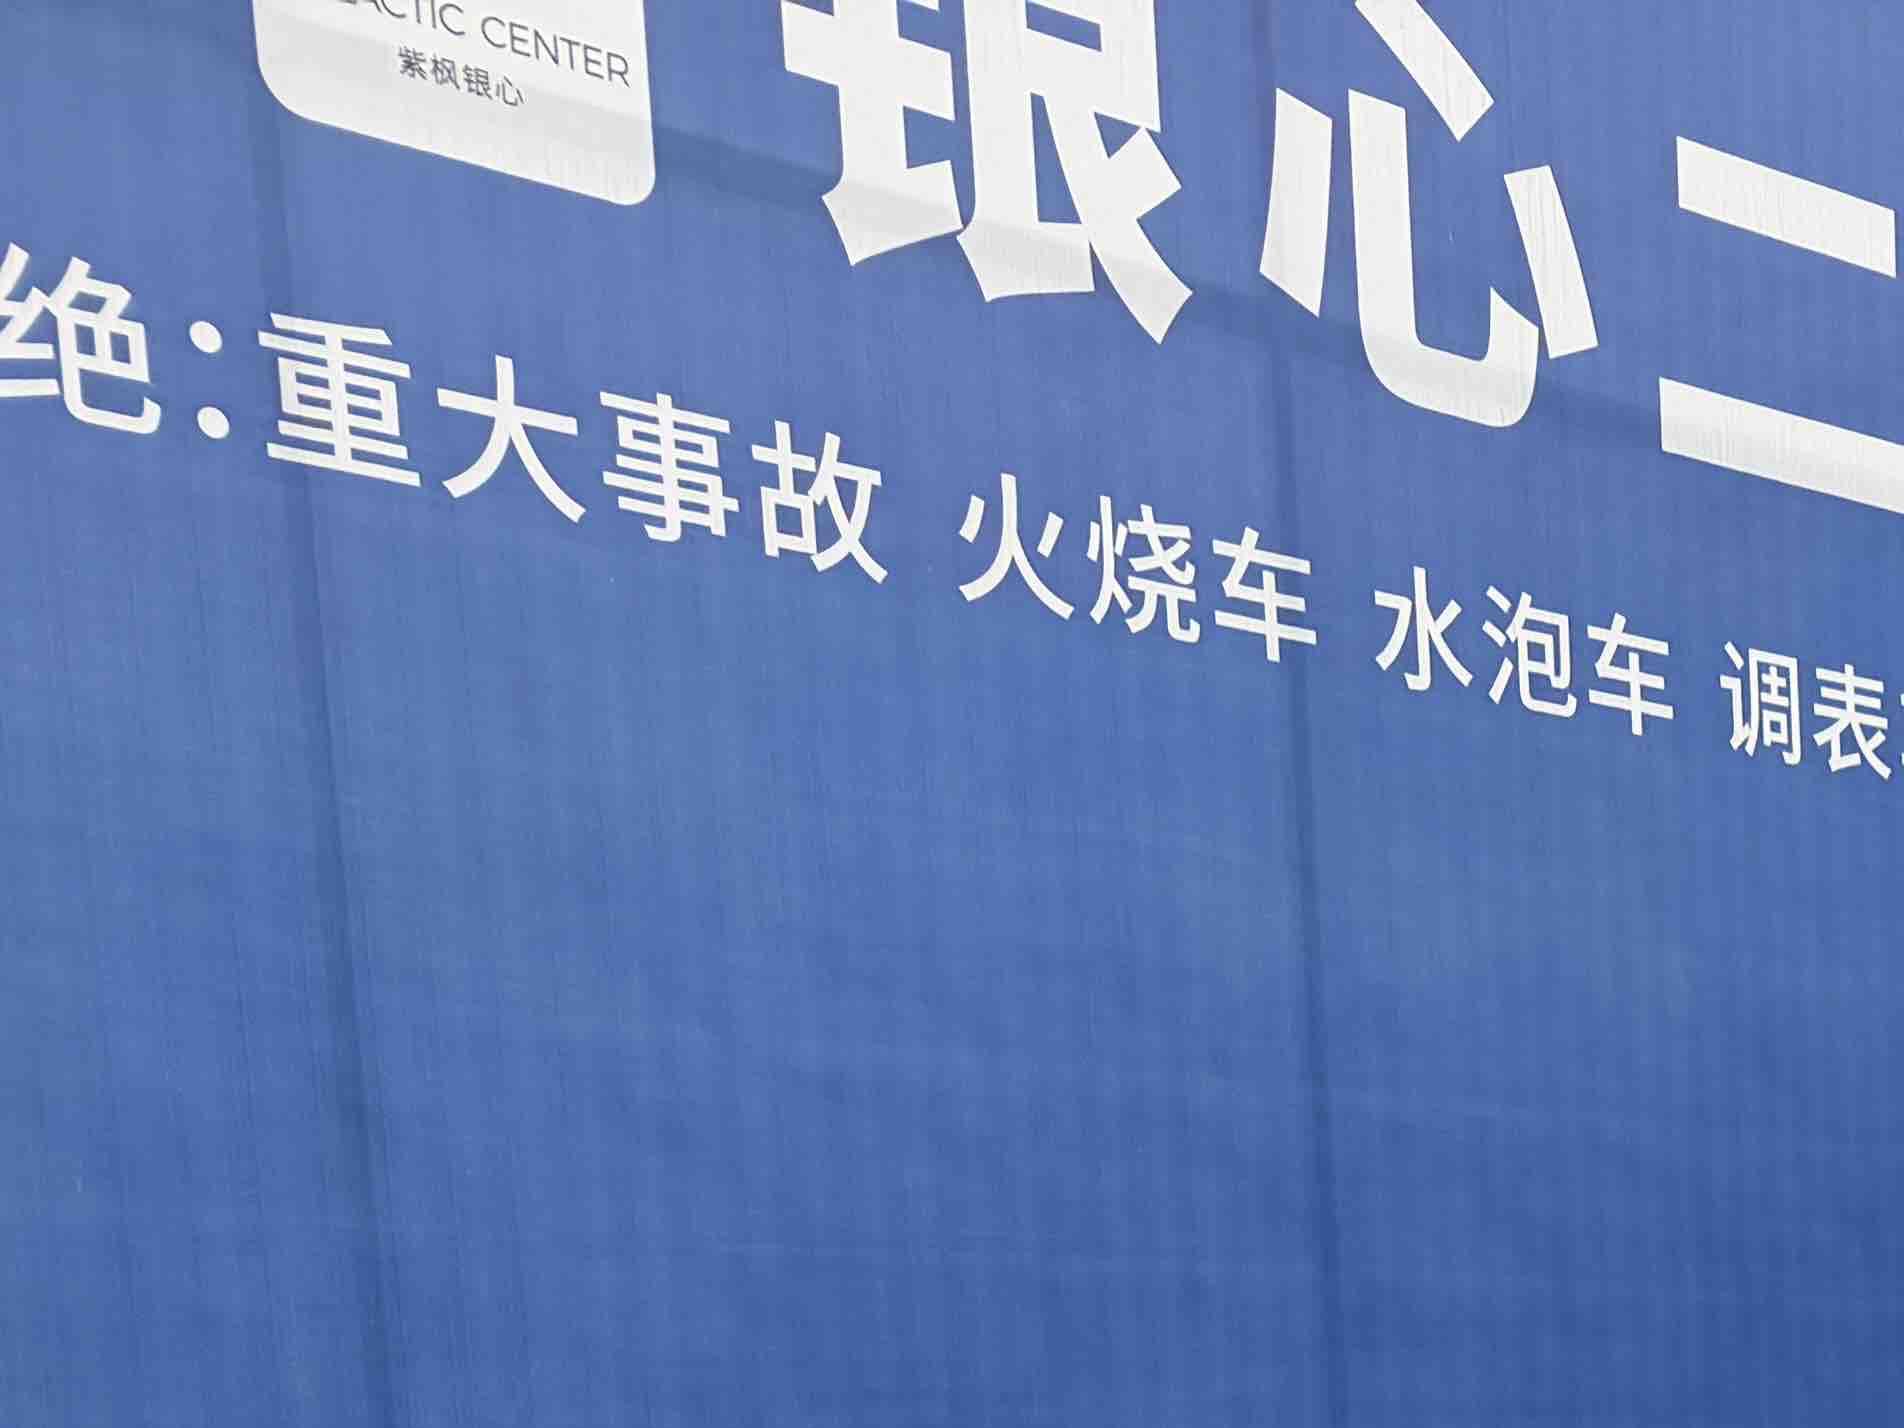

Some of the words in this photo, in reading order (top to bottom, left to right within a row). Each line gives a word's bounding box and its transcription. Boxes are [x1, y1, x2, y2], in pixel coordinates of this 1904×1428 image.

[396, 45, 526, 107] 紫枫银心
[480, 16, 632, 88] CENTER
[959, 472, 1318, 663] 火烧车
[1374, 566, 1675, 737] 水泡车
